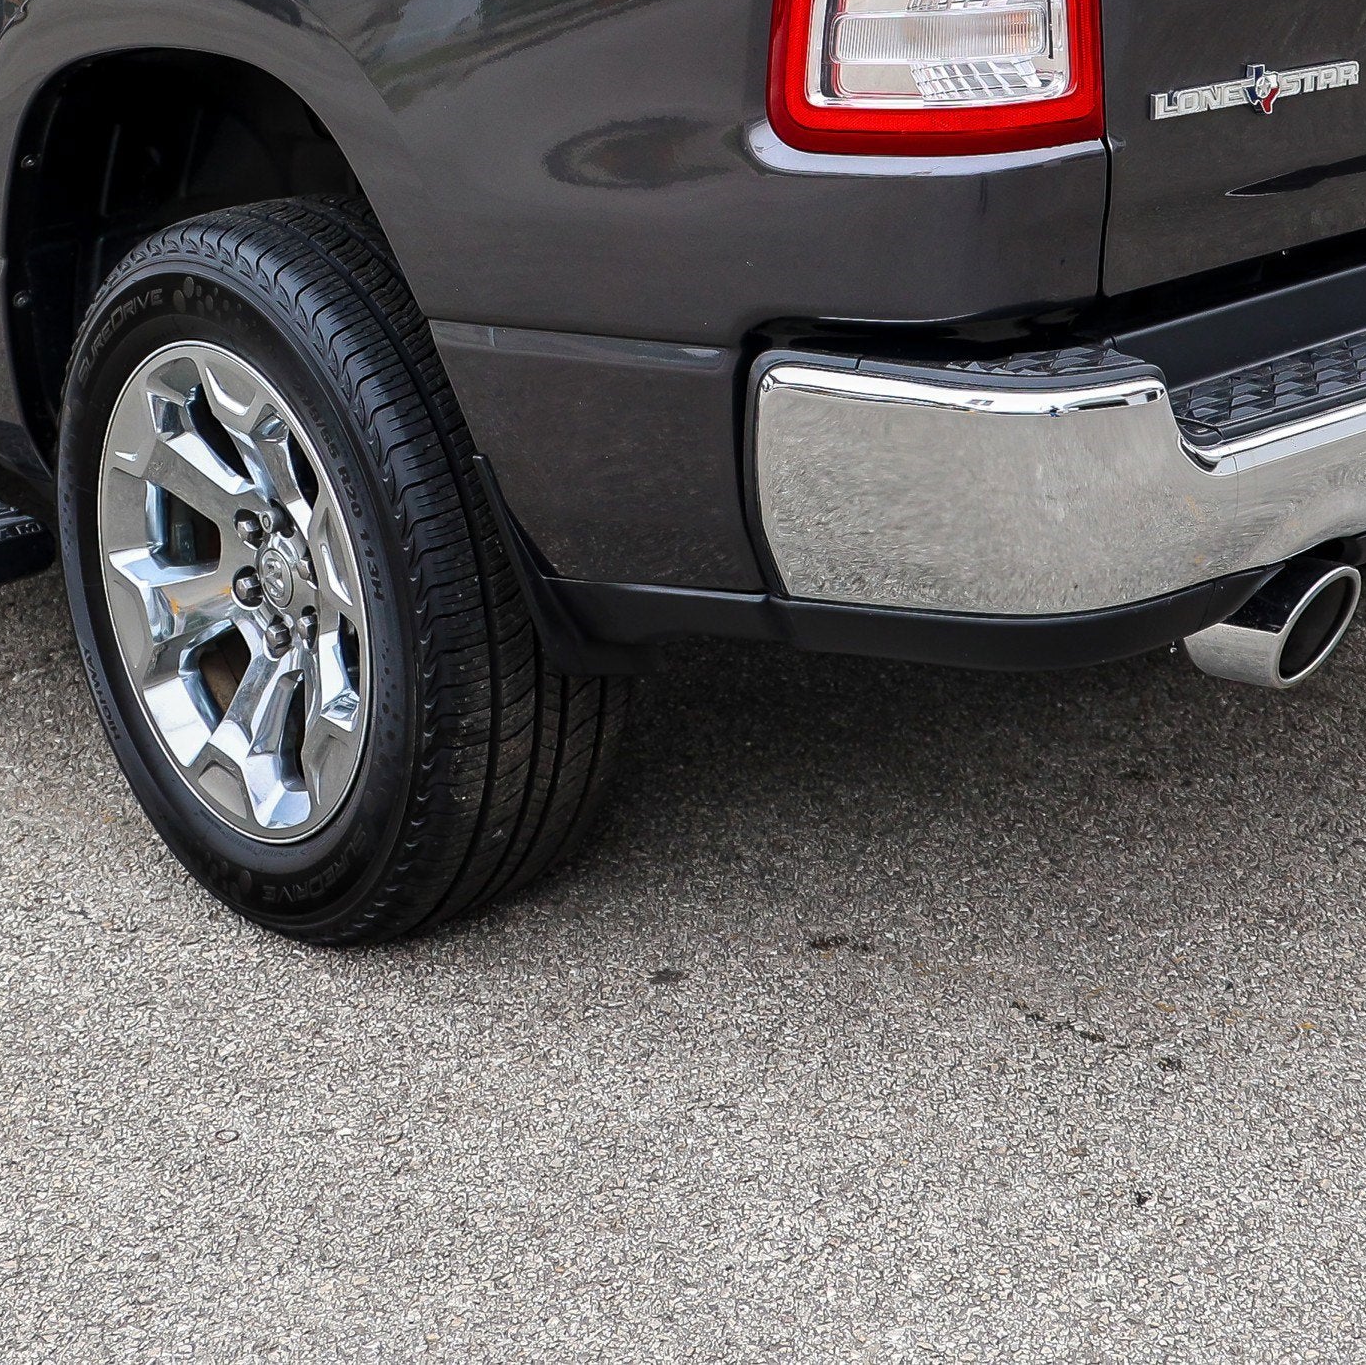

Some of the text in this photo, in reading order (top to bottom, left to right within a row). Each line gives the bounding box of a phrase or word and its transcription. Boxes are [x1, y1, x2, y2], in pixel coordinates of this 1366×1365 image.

[1150, 60, 1360, 120] LONE STAR
[77, 287, 164, 384] SUREDRIVE
[337, 465, 363, 519] R20
[81, 644, 122, 740] HIGHWAY
